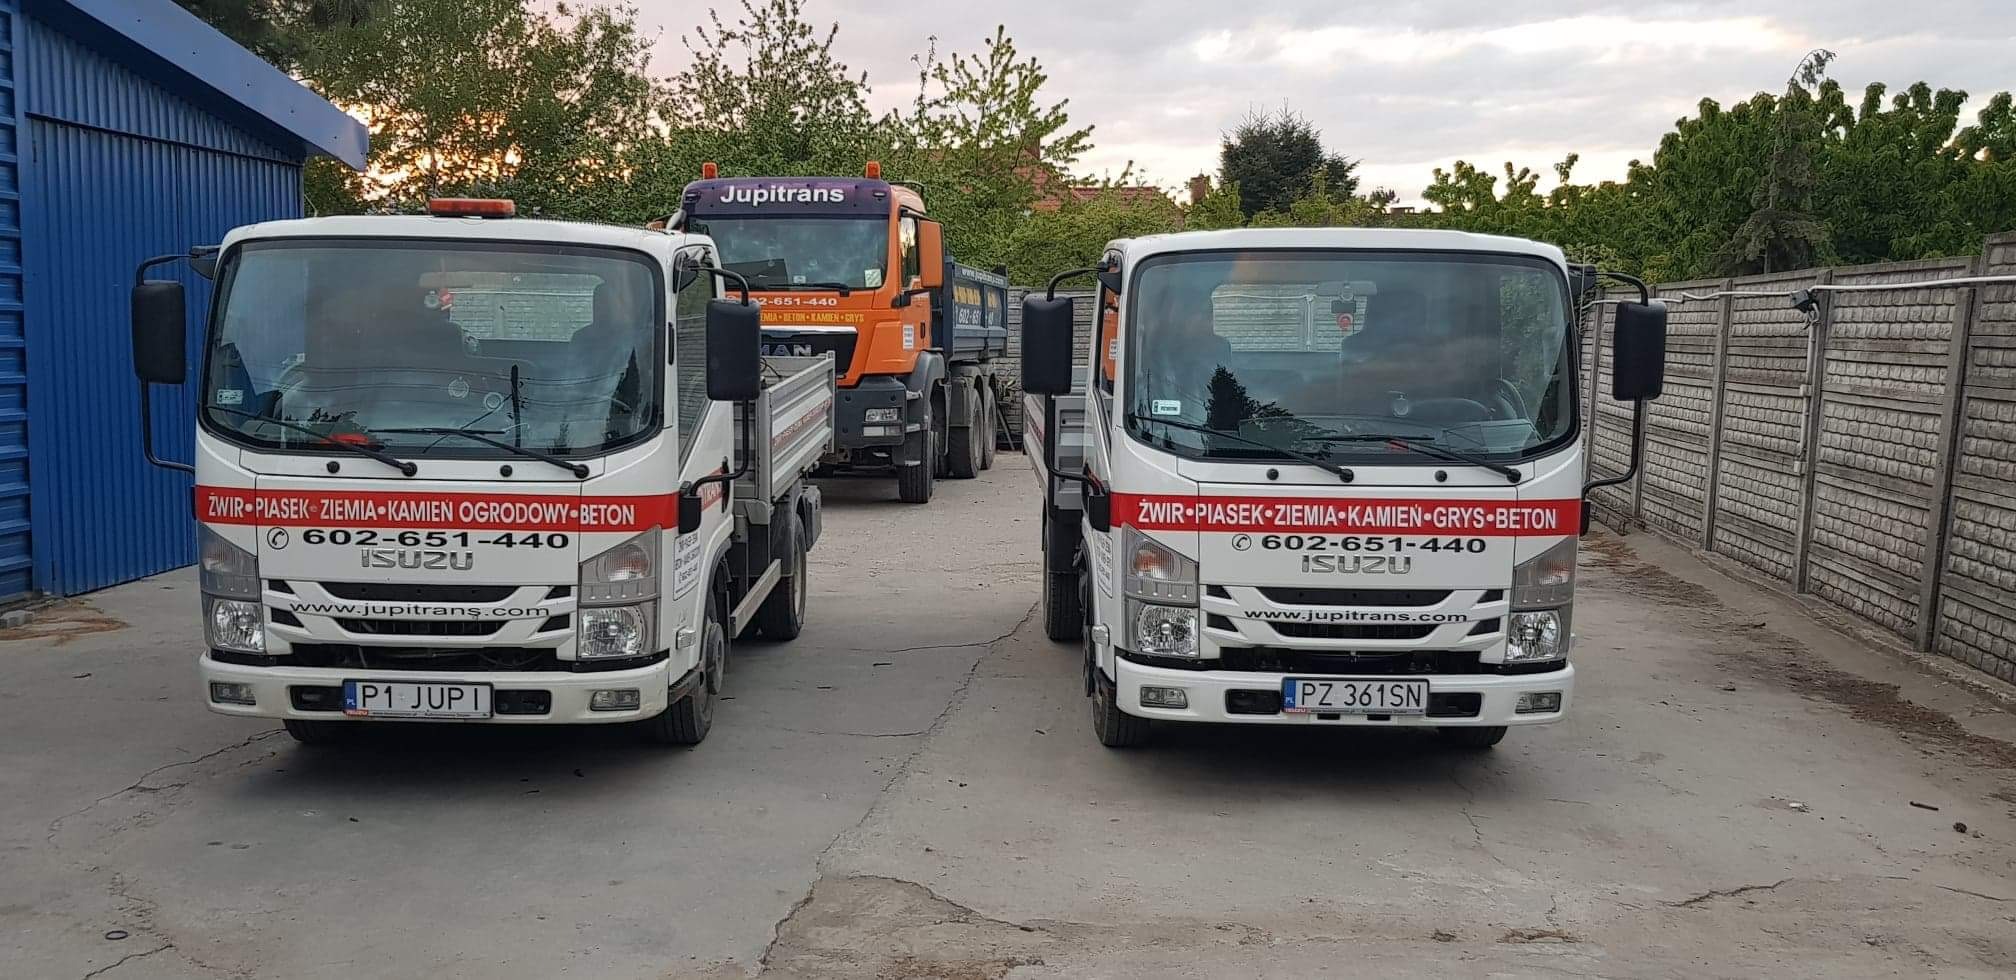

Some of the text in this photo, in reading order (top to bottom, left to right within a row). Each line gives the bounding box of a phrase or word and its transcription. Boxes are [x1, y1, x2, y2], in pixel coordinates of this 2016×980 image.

[720, 184, 845, 207] Jupitrans
[750, 297, 837, 306] 2-651-440
[845, 313, 865, 323] GRYS
[208, 492, 635, 526] ŻWIR PIASEK ZIEMIA KAMIEŃ OGRODOWY BETON
[1138, 499, 1557, 529] ŻWIR PIASEK ZIEMIA KAMIEŃ GRYS BETON
[302, 528, 570, 549] 602-651-440
[1261, 535, 1486, 554] 602-651-440
[361, 548, 473, 571] ISUZU
[1301, 554, 1411, 575] ISUZU
[290, 602, 550, 618] www.jupitrans.com
[1244, 610, 1468, 622] www.jupitrans.com
[362, 684, 393, 708] P1
[1301, 683, 1422, 707] PZ 361SN
